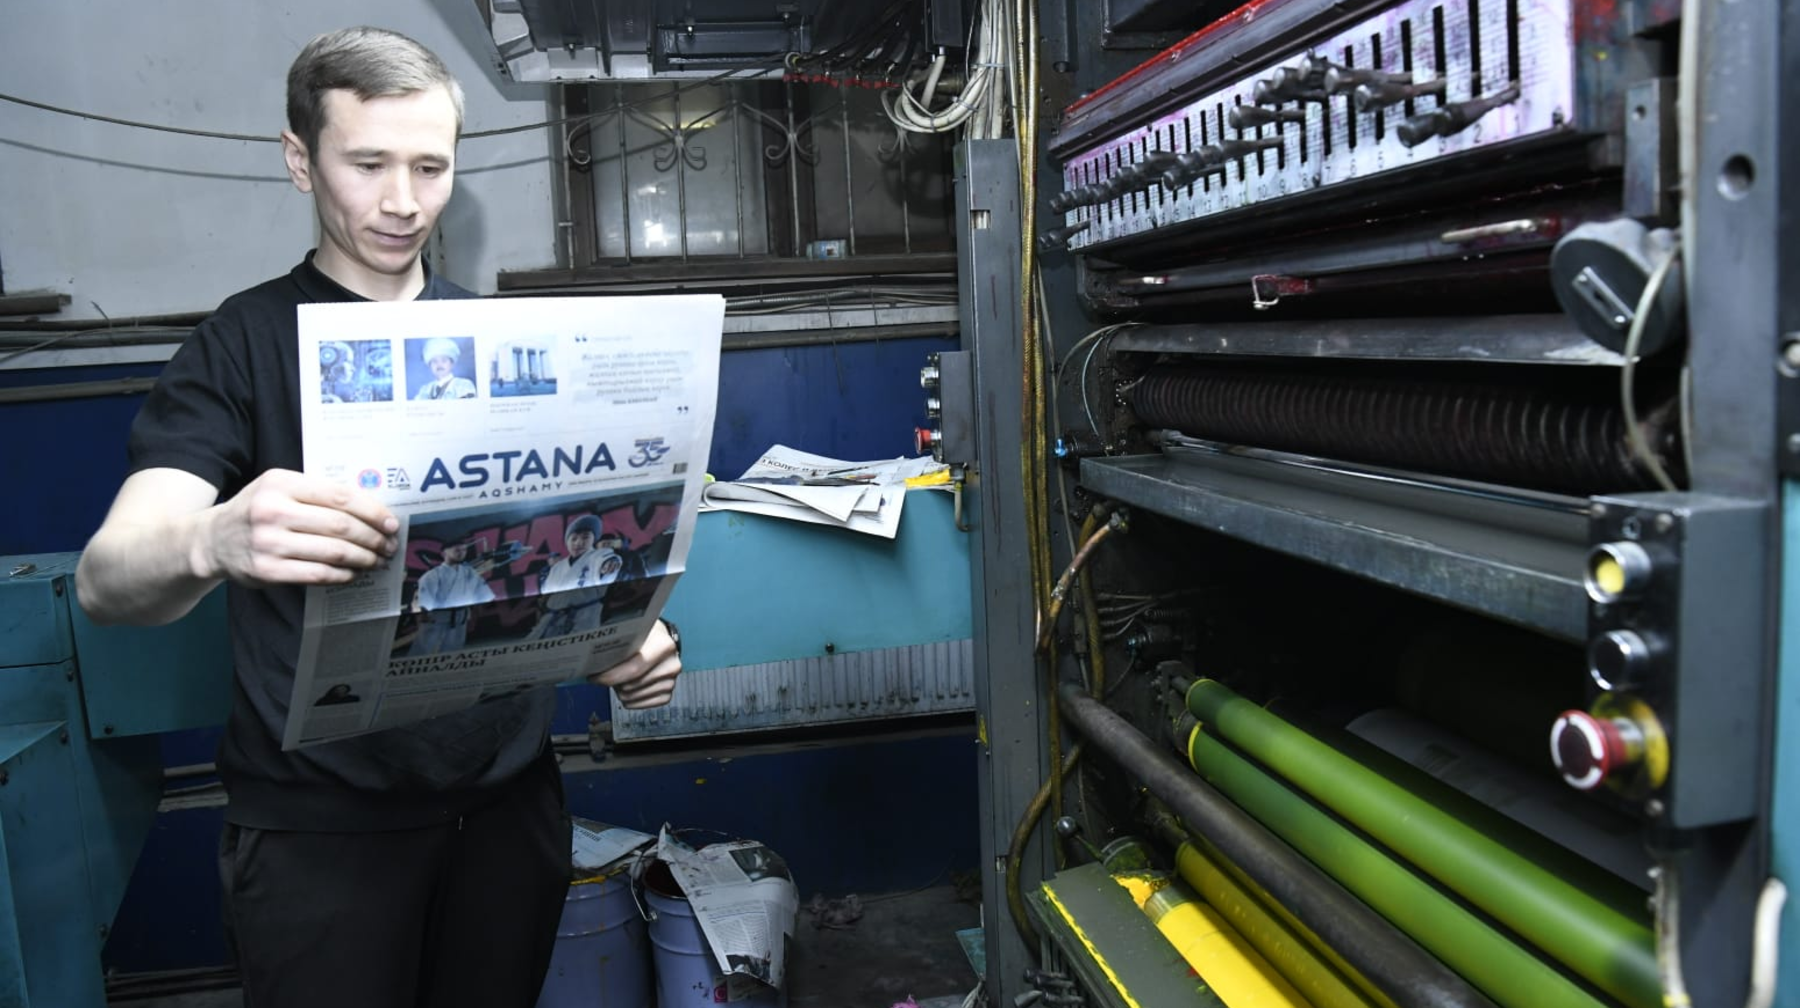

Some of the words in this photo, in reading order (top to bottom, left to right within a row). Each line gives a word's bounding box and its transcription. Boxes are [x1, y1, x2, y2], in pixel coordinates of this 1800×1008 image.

[1350, 158, 1358, 176] 6
[1378, 150, 1385, 168] 5
[1474, 123, 1482, 144] 2
[420, 442, 616, 494] ASTANA
[478, 480, 564, 499] AQSHAMY
[457, 646, 509, 660] АСТЫ
[512, 626, 619, 654] КЕҢІСТІККЕ
[385, 658, 487, 678] АЙНАЛДЫ
